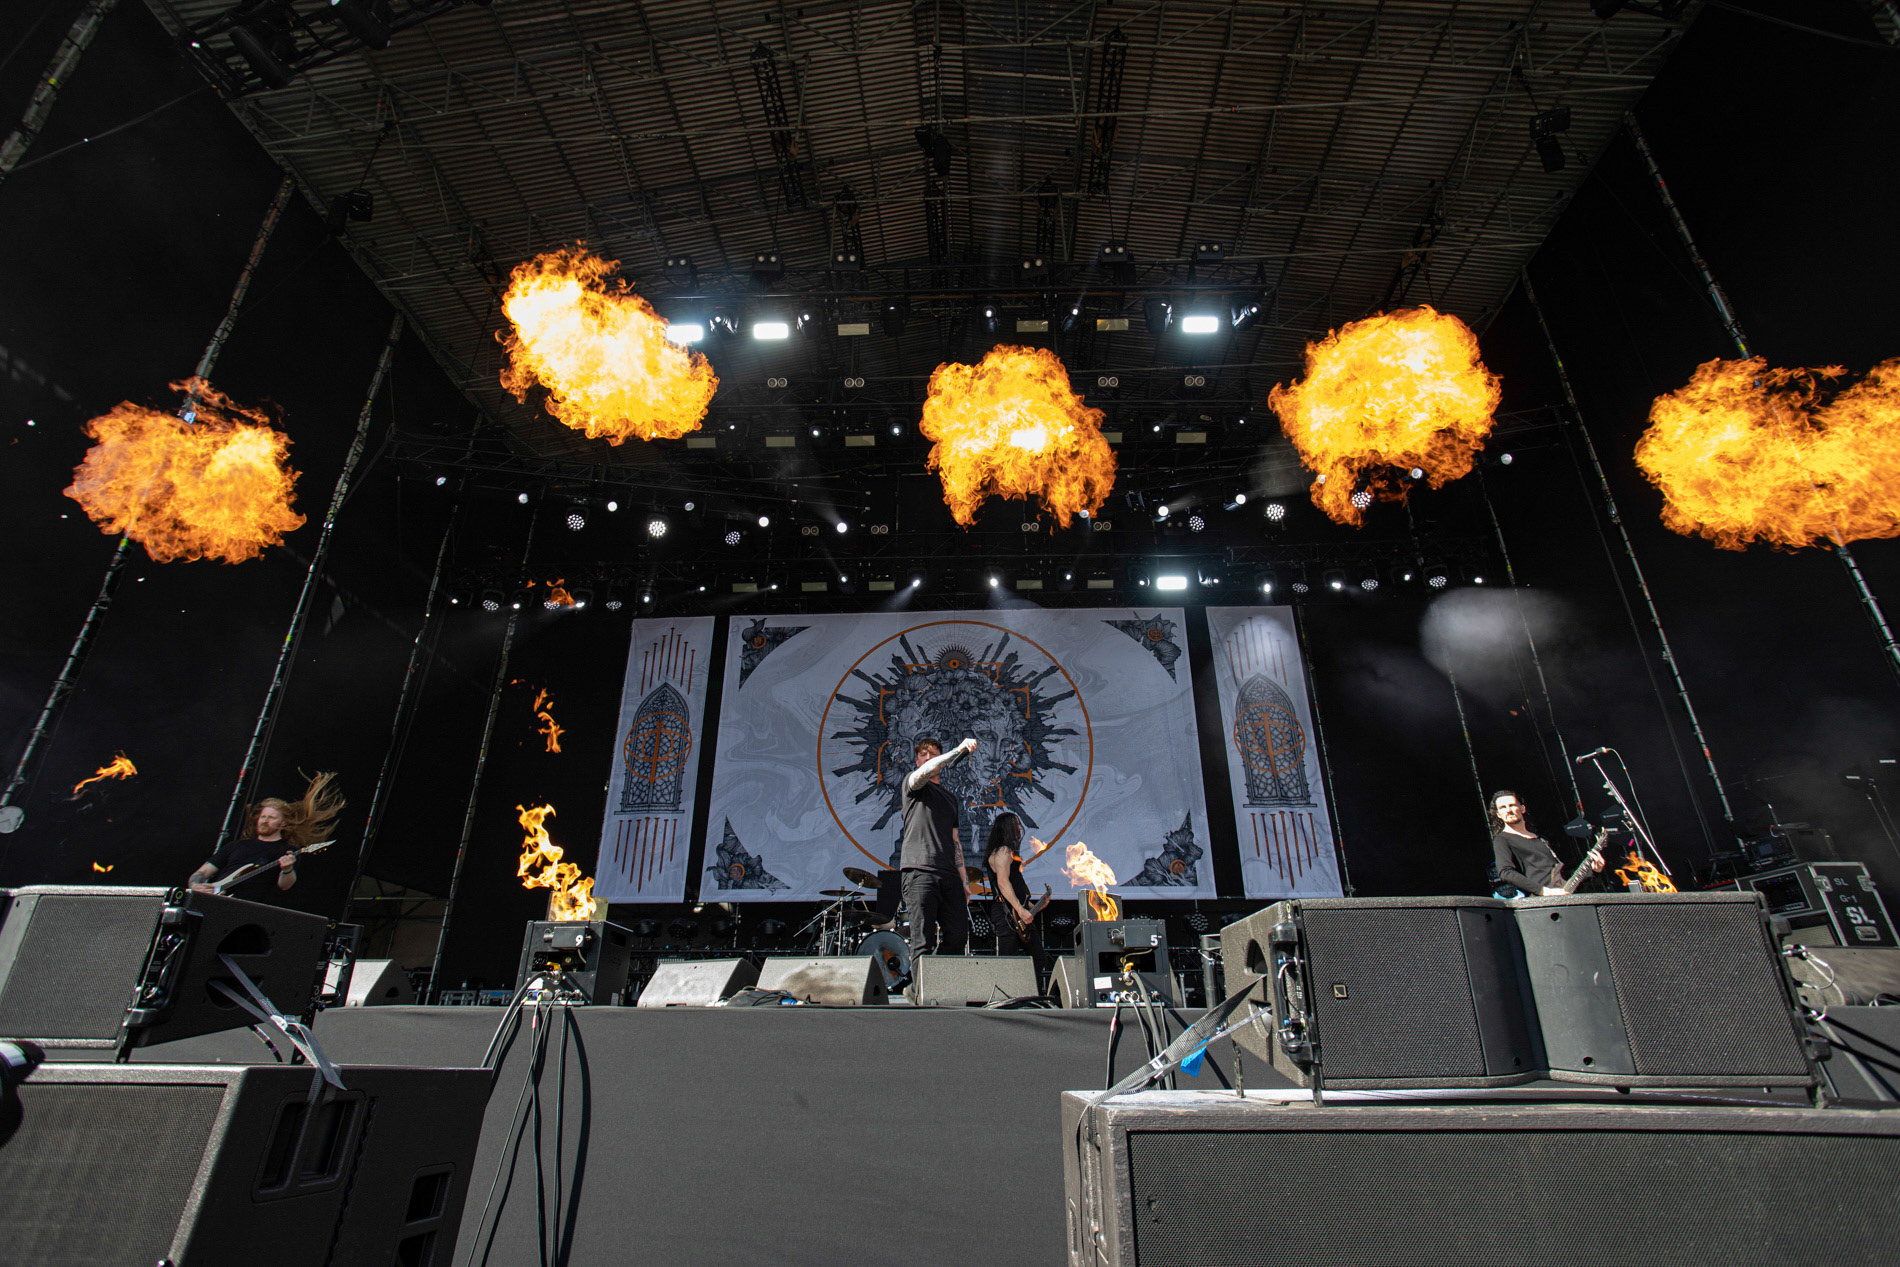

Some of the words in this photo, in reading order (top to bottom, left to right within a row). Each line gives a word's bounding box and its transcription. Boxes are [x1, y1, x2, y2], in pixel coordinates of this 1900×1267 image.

[1833, 877, 1849, 886] SL
[1845, 906, 1877, 925] SL
[575, 934, 584, 946] 9
[1150, 934, 1159, 946] 5
